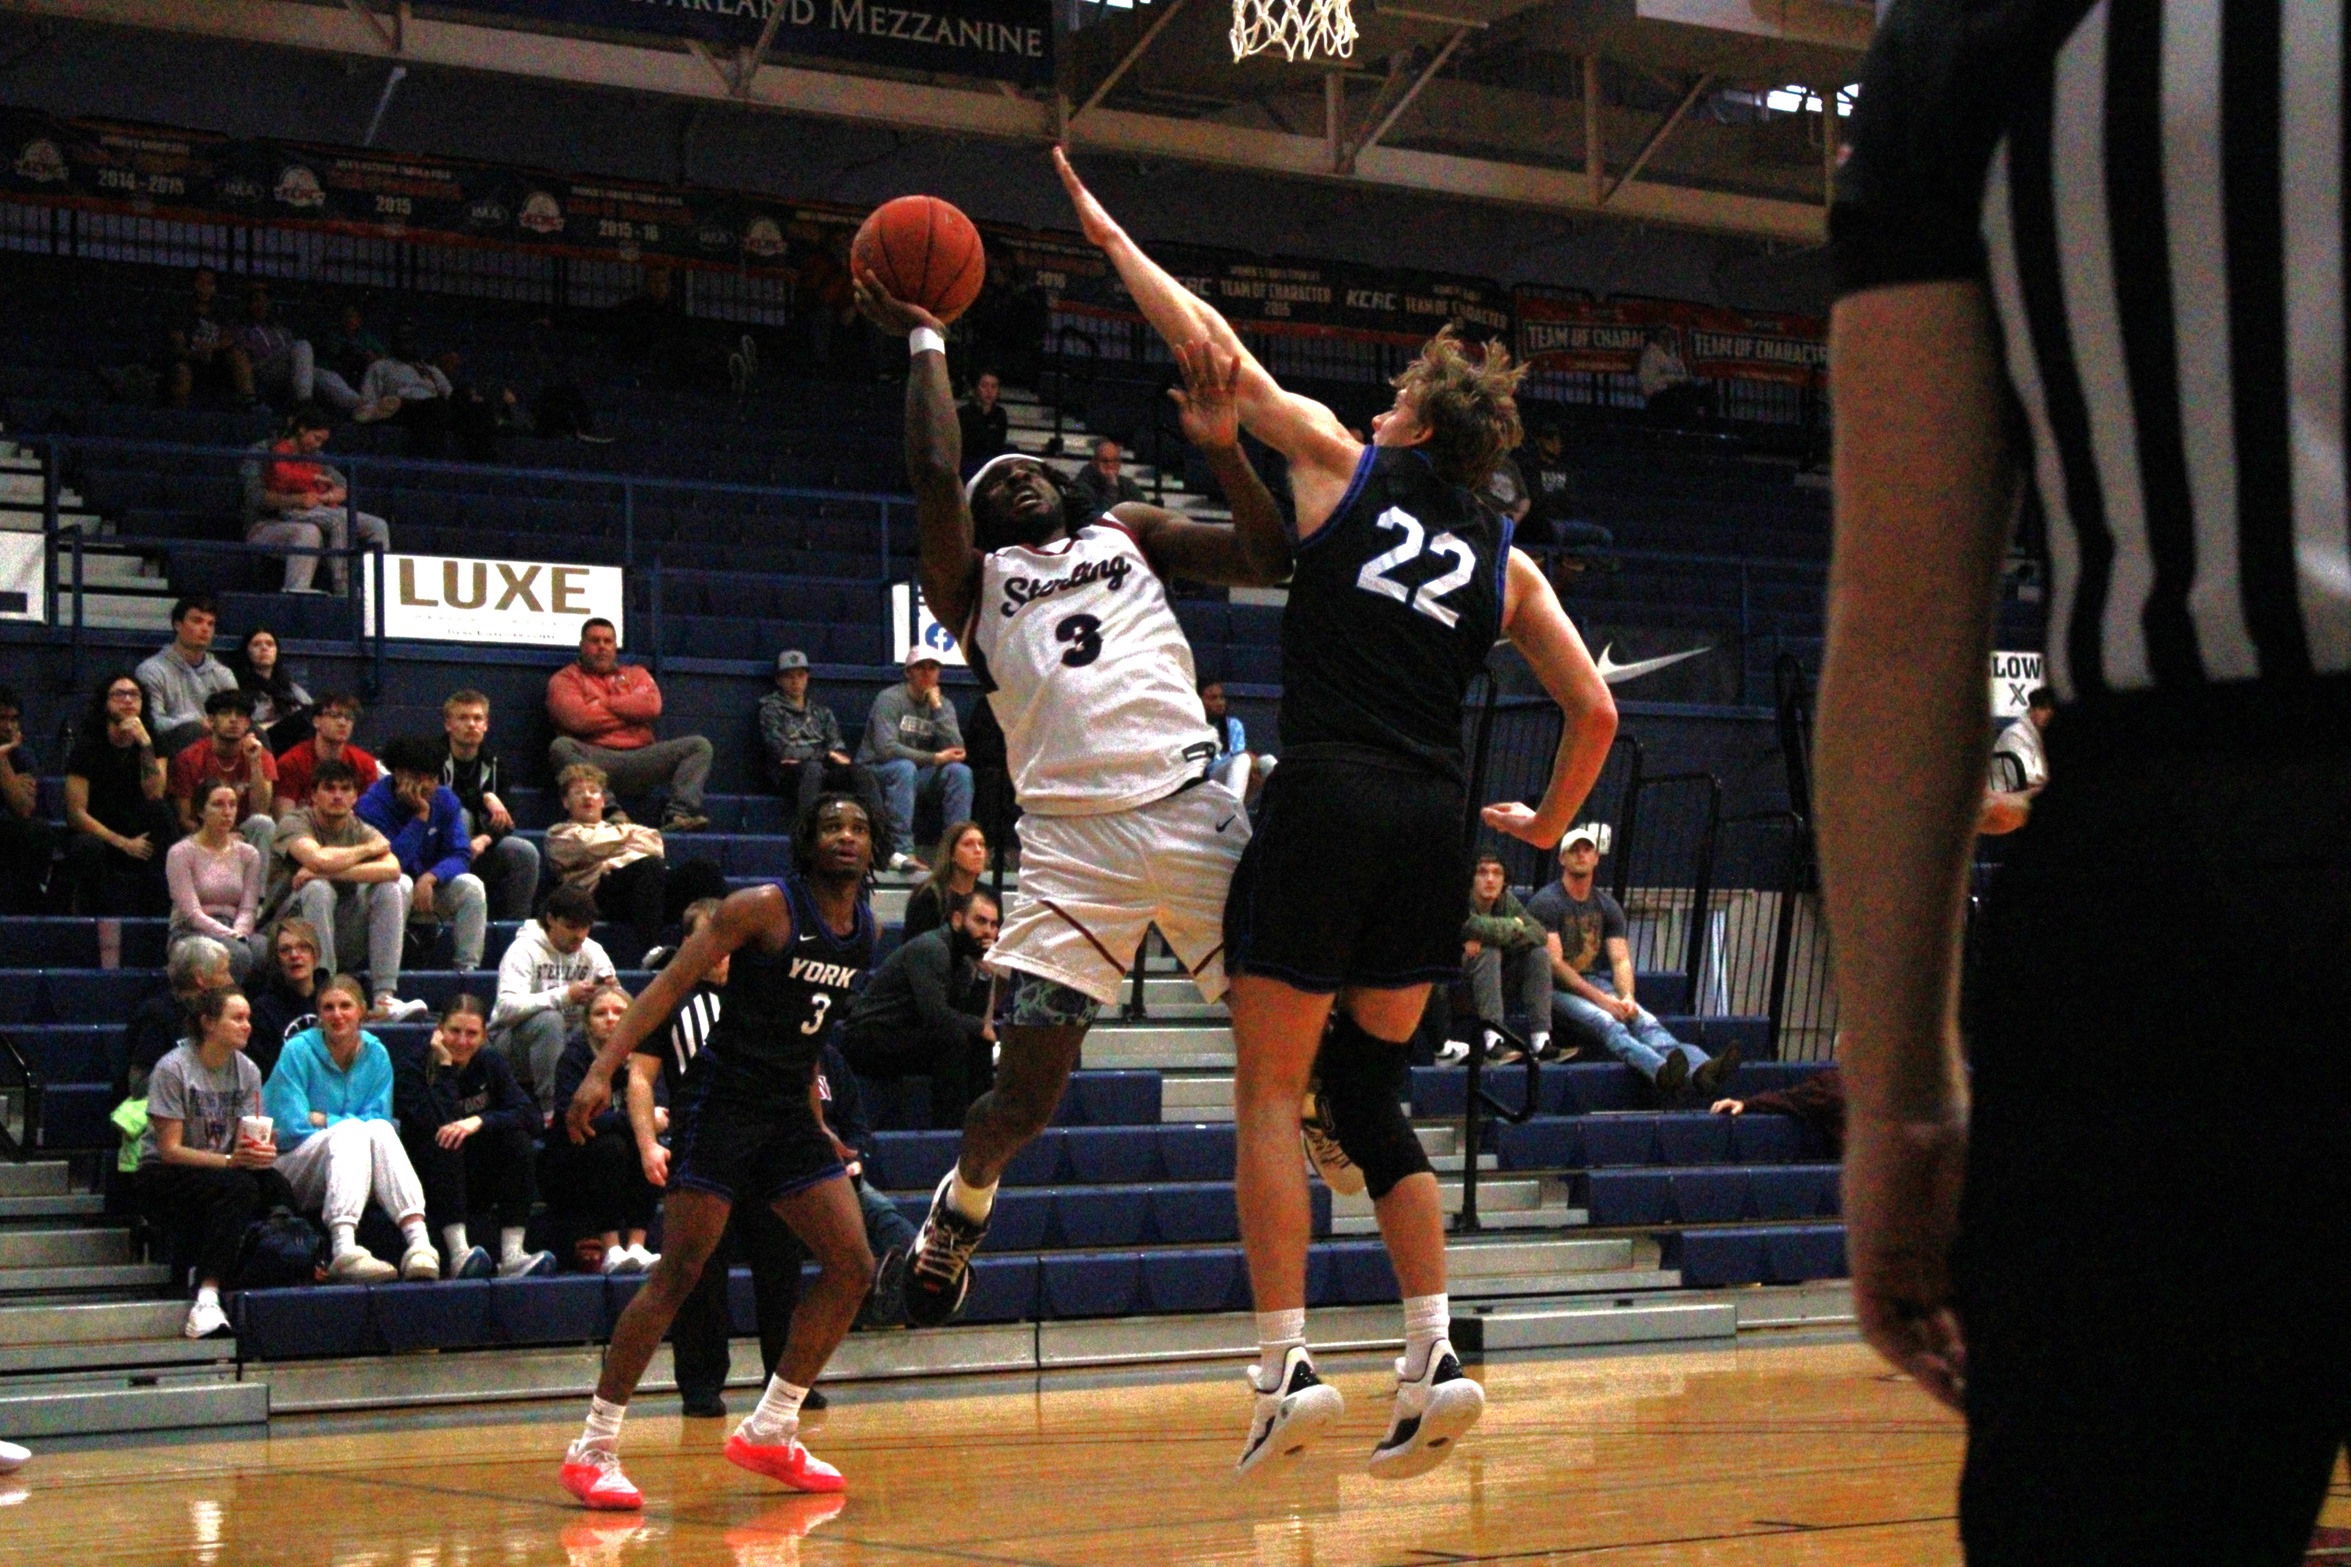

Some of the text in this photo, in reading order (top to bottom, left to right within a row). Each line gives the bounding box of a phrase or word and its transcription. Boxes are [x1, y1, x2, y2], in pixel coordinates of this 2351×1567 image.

[830, 0, 1044, 58] MEZZANINE
[1528, 325, 1568, 349] TEAM
[1571, 328, 1590, 347] OF
[1693, 332, 1732, 356] TEAM
[1734, 337, 1753, 357] OF
[399, 557, 592, 615] LUXE
[1356, 505, 1477, 629] 22
[1056, 613, 1102, 667] 3
[788, 957, 858, 989] YORK
[800, 992, 832, 1036] 3
